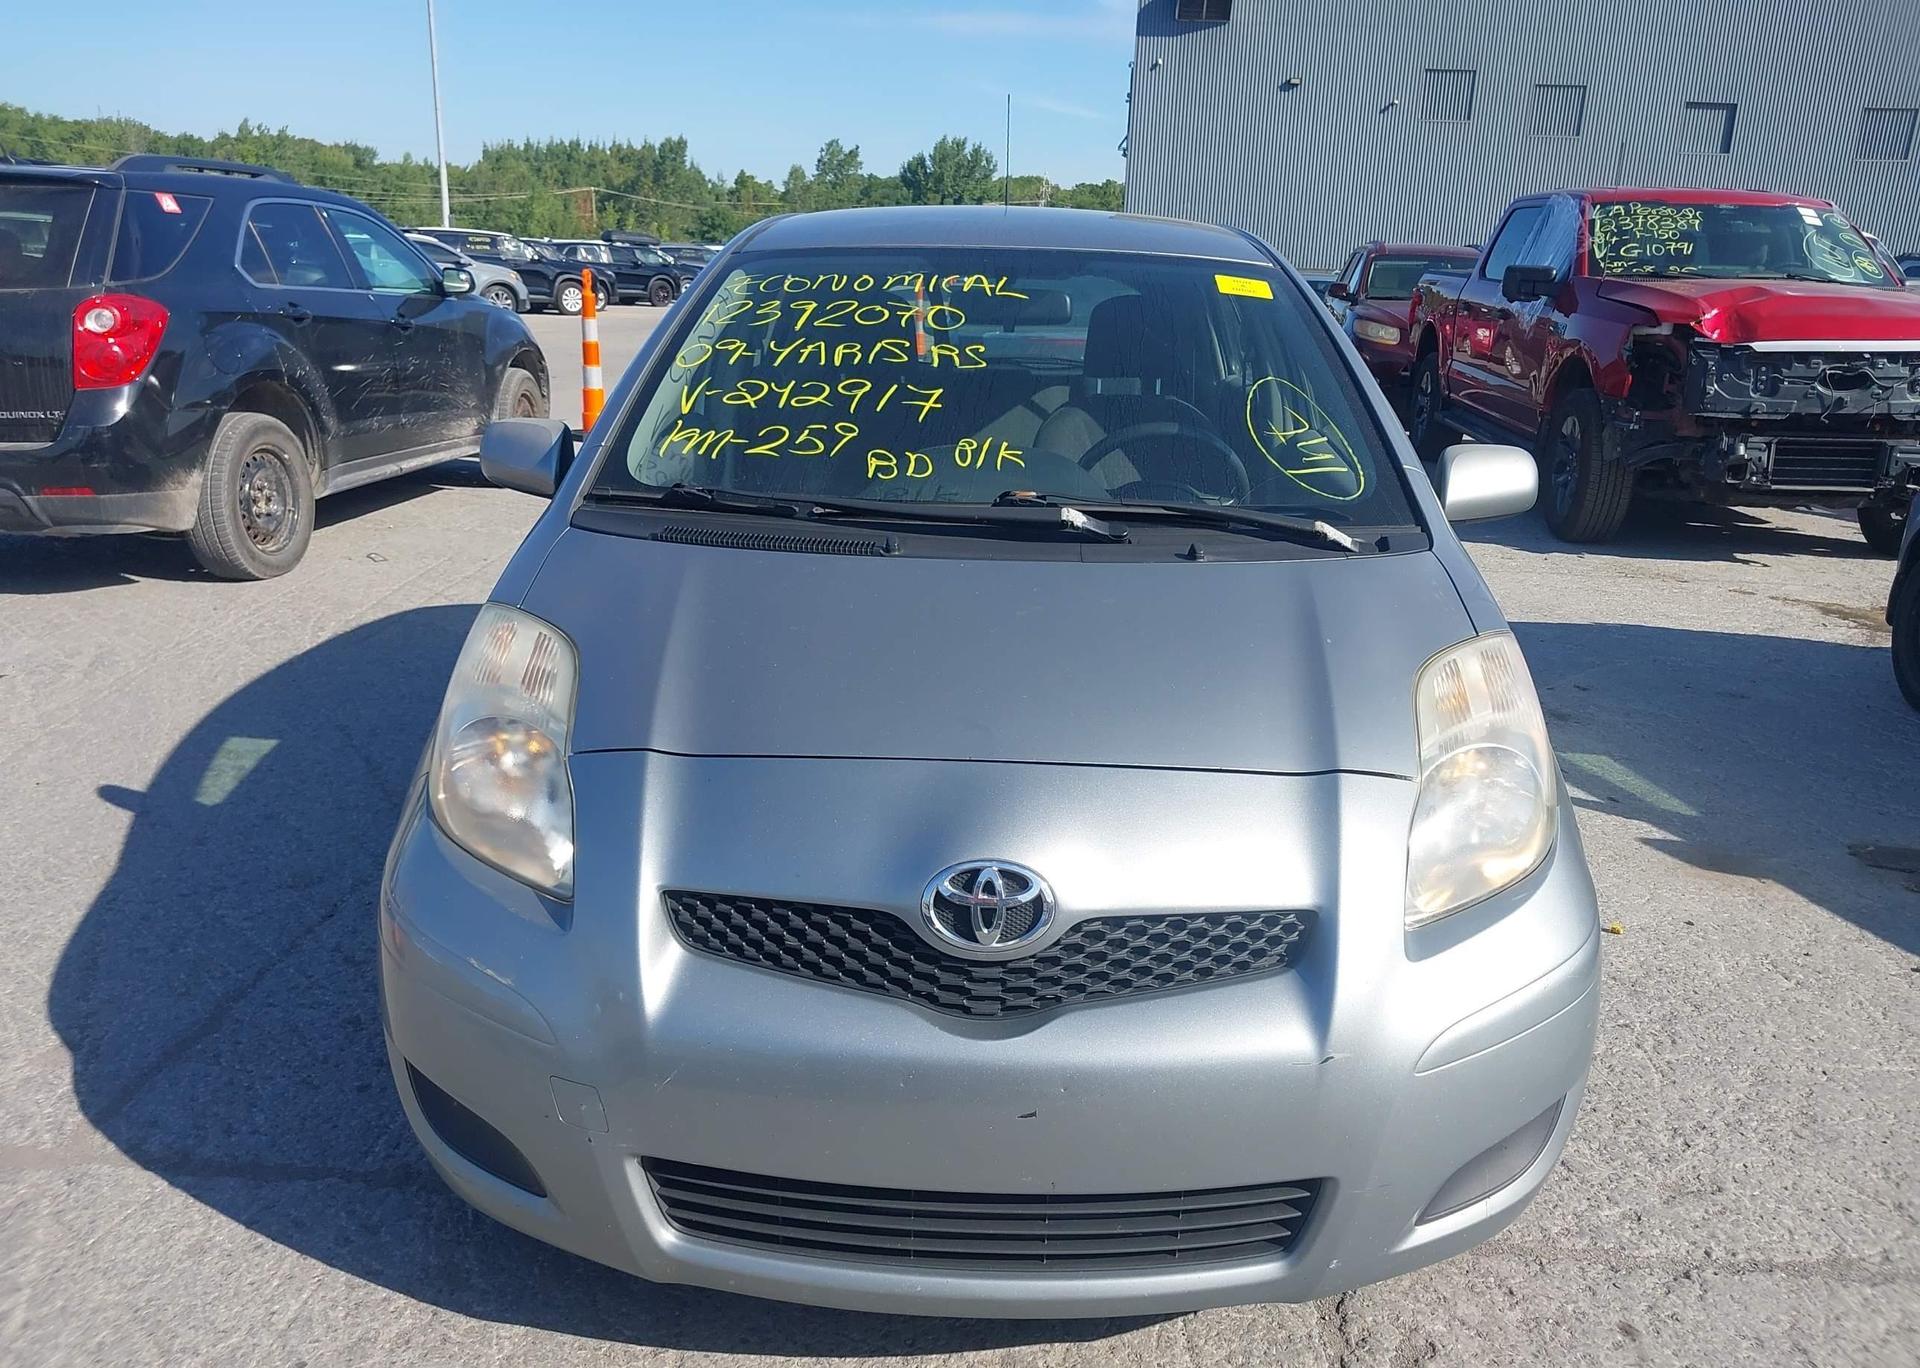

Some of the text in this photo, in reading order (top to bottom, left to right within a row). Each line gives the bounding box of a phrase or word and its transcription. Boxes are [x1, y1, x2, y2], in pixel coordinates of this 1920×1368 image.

[726, 272, 1030, 301] ECONOMICAL
[701, 300, 967, 332] 12392070
[930, 343, 988, 369] RS
[680, 376, 944, 423] V-242917
[0, 410, 46, 419] QUINOX
